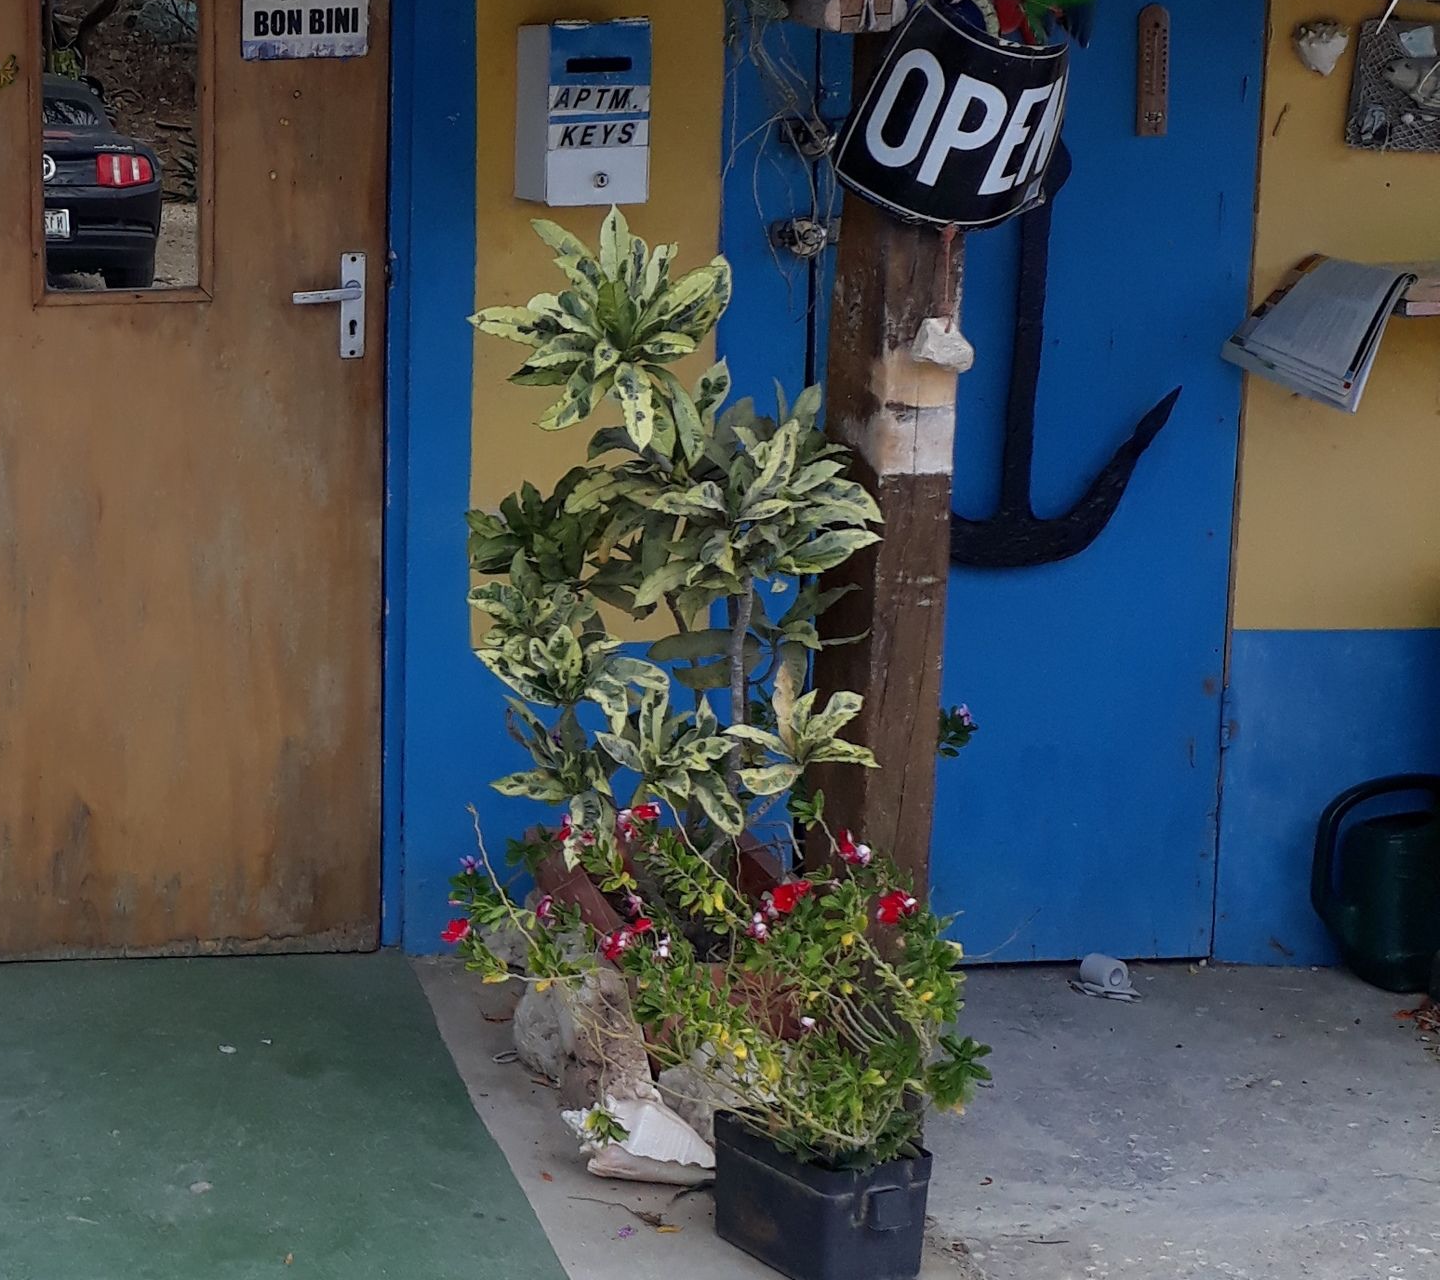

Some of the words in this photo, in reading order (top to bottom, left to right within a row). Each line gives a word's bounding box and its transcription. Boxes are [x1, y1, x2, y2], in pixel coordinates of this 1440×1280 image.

[254, 9, 302, 36] BON
[309, 7, 359, 34] BINI
[554, 87, 638, 109] APTM.
[560, 122, 635, 146] KEYS
[865, 48, 1064, 195] OPEN
